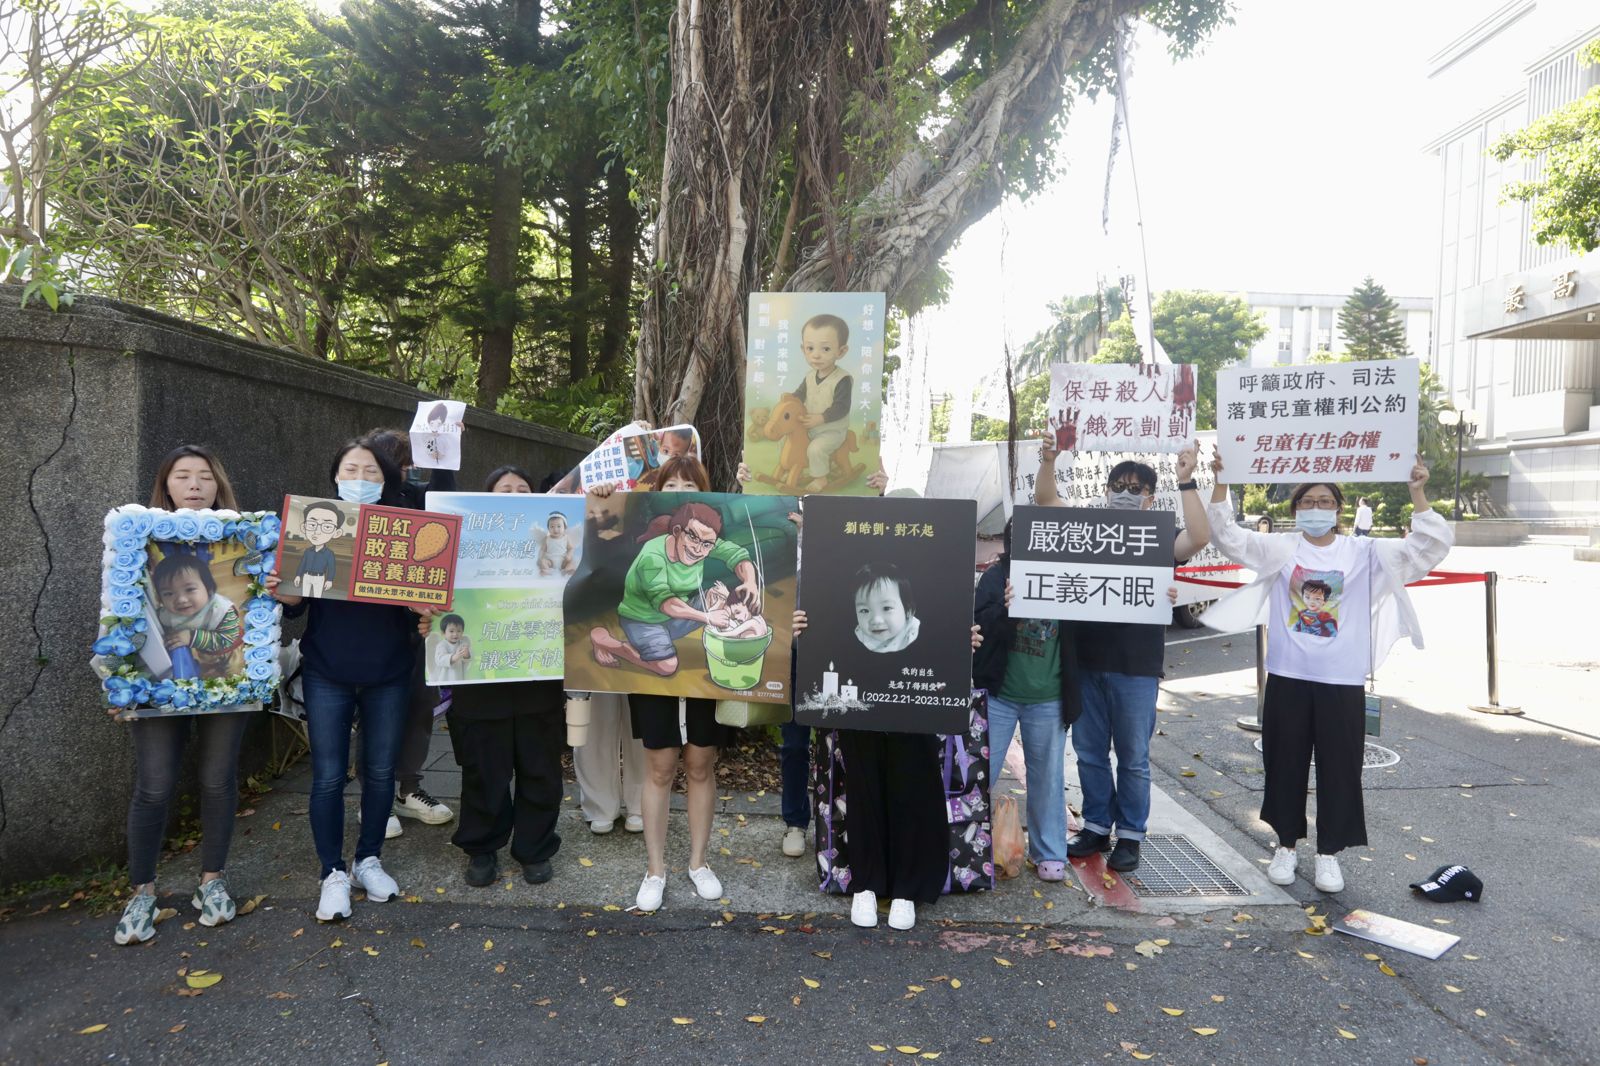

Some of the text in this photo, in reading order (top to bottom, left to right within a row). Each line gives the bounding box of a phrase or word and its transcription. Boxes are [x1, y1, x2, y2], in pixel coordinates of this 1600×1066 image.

[1063, 380, 1166, 402] 保母殺人
[1239, 366, 1396, 393] 呼籲政府、司法
[1227, 394, 1406, 420] 落實兒童權利公約
[1084, 414, 1188, 439] 餓死剴剴
[368, 514, 412, 537] 凱紅
[364, 537, 409, 560] 敢蓋
[1028, 521, 1159, 556] 嚴懲兇手
[362, 560, 447, 585] 營養雞排
[1023, 572, 1154, 607] 正義不眠
[482, 620, 564, 641] 兒虐零容
[862, 691, 971, 708] (2022.2.21-2023.12.24)
